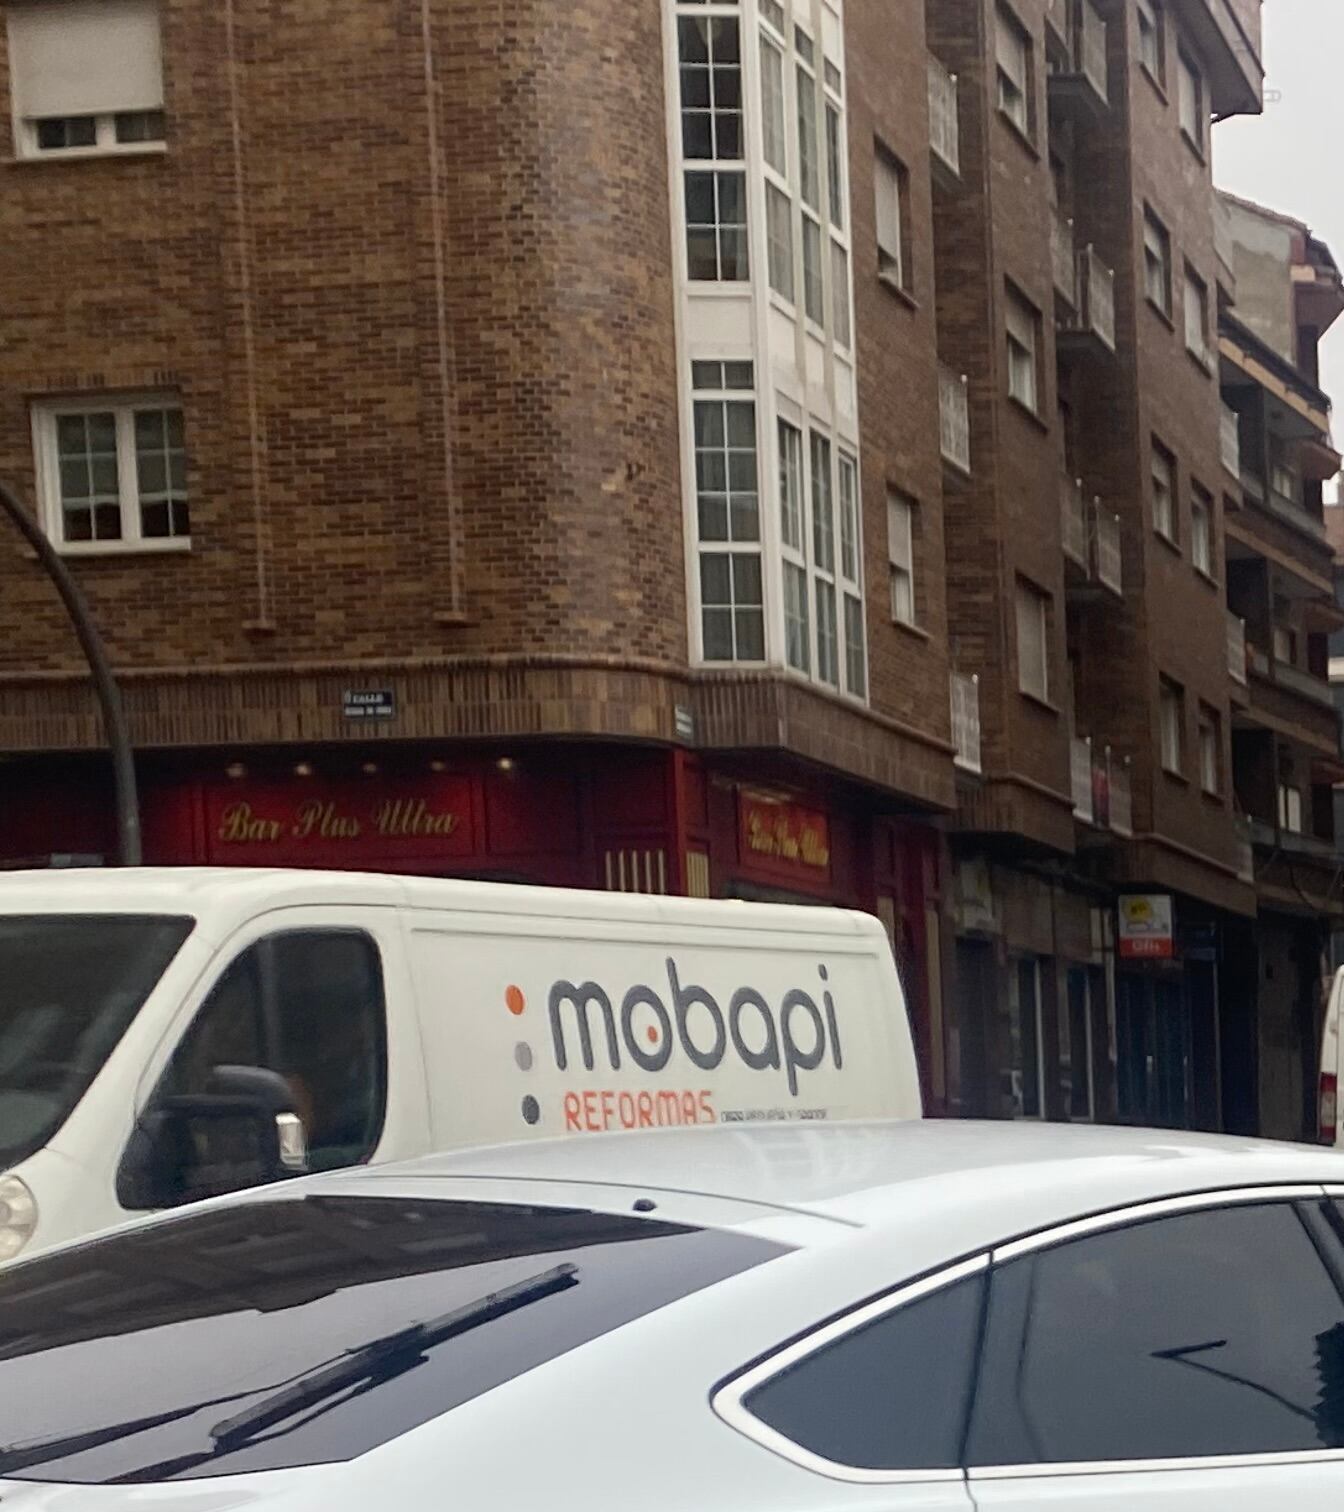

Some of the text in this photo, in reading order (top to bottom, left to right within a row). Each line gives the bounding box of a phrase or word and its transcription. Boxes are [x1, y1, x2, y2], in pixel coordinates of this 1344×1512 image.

[219, 798, 461, 842] Bar Plus Ultra
[548, 956, 843, 1096] mobapi
[563, 1090, 717, 1132] REFORMAS
